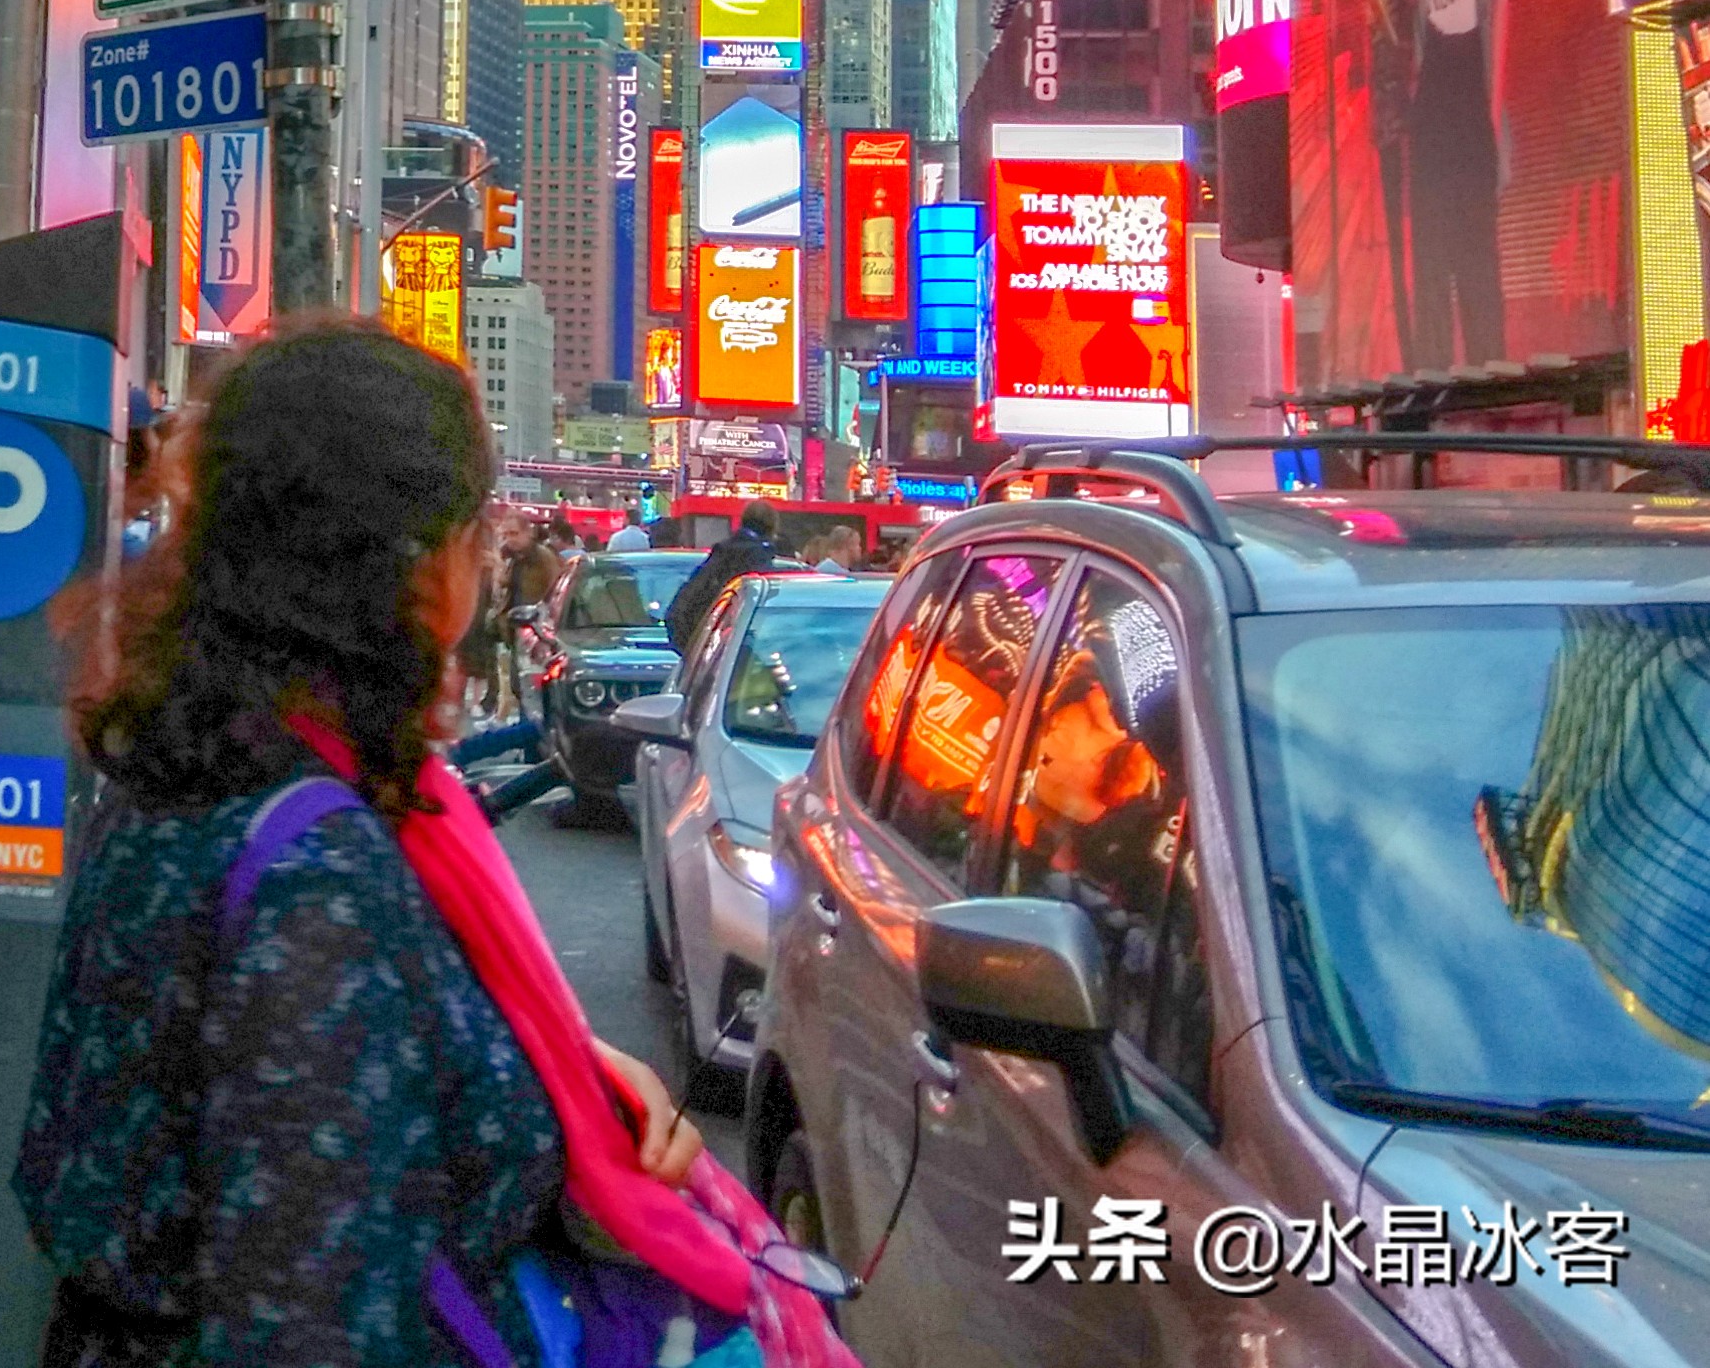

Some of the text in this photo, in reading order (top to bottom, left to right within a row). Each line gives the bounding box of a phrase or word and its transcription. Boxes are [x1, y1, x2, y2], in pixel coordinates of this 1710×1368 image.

[91, 39, 150, 67] Zone#
[722, 44, 780, 57] XINHUA
[1035, 0, 1058, 102] 1500
[92, 57, 265, 130] 101801
[616, 66, 637, 179] NOVOTEL
[220, 136, 245, 282] NYPD
[1020, 194, 1058, 213] THE
[1061, 194, 1115, 213] NEW
[897, 360, 921, 375] AND
[1013, 382, 1169, 399] TOMMY HILFIGER
